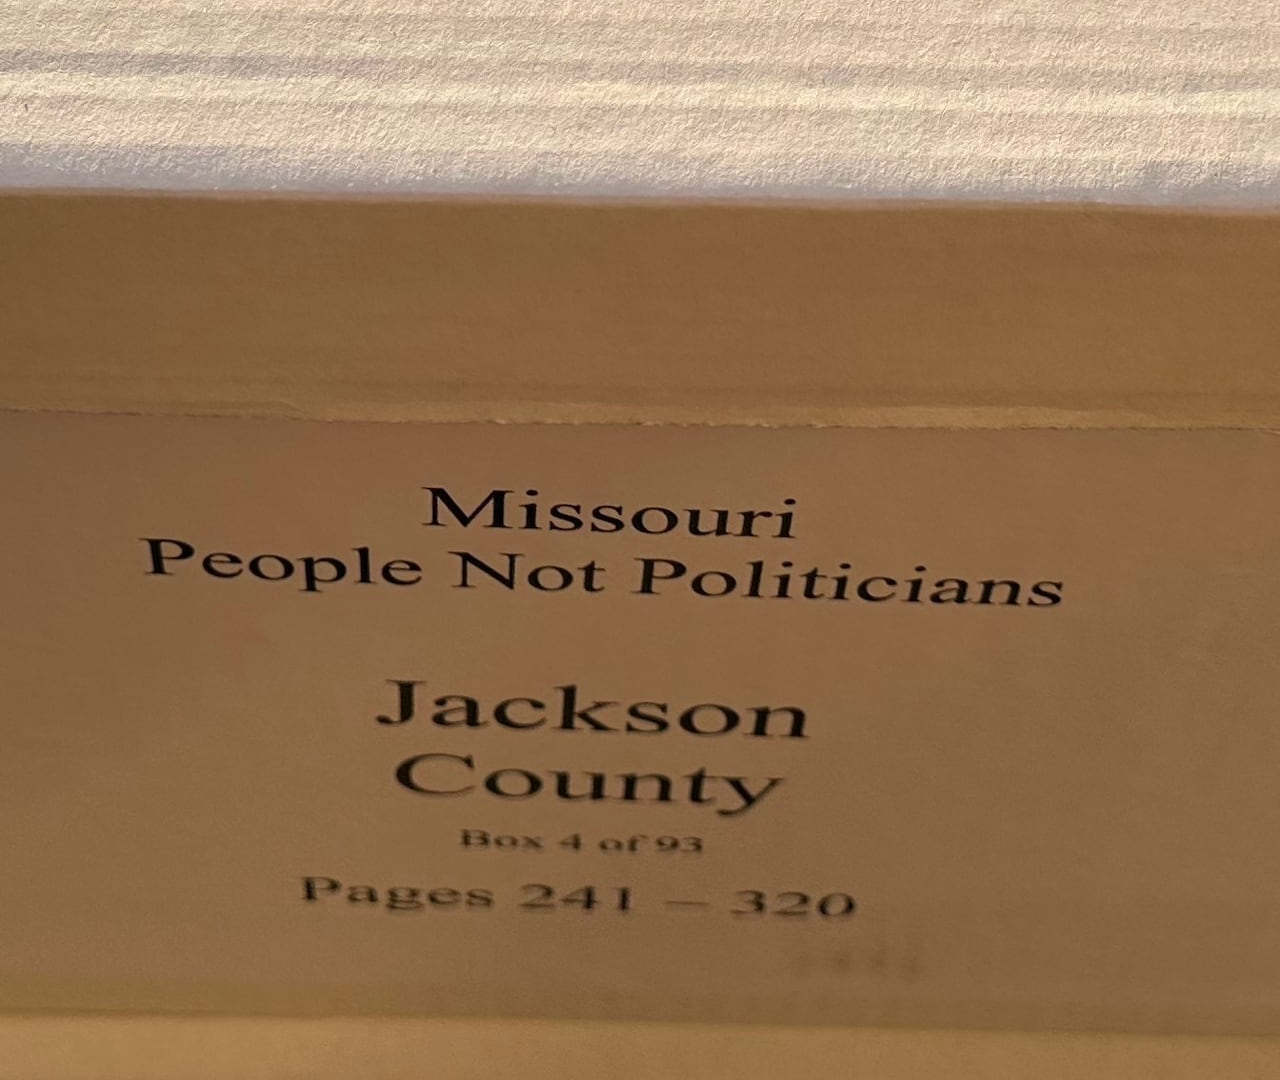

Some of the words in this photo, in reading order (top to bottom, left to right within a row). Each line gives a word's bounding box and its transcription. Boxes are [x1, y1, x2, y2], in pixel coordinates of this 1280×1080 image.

[421, 485, 798, 540] Missouri
[140, 537, 423, 594] People
[447, 550, 606, 594] Not
[634, 557, 1065, 608] Politicians
[375, 678, 808, 740] Jackson
[394, 752, 785, 818] County
[459, 828, 544, 850] Box
[558, 832, 583, 852] 4
[597, 833, 649, 854] of
[655, 835, 704, 855] 93
[301, 875, 495, 912] Pages
[520, 883, 632, 914] 241
[732, 889, 857, 919] 320
